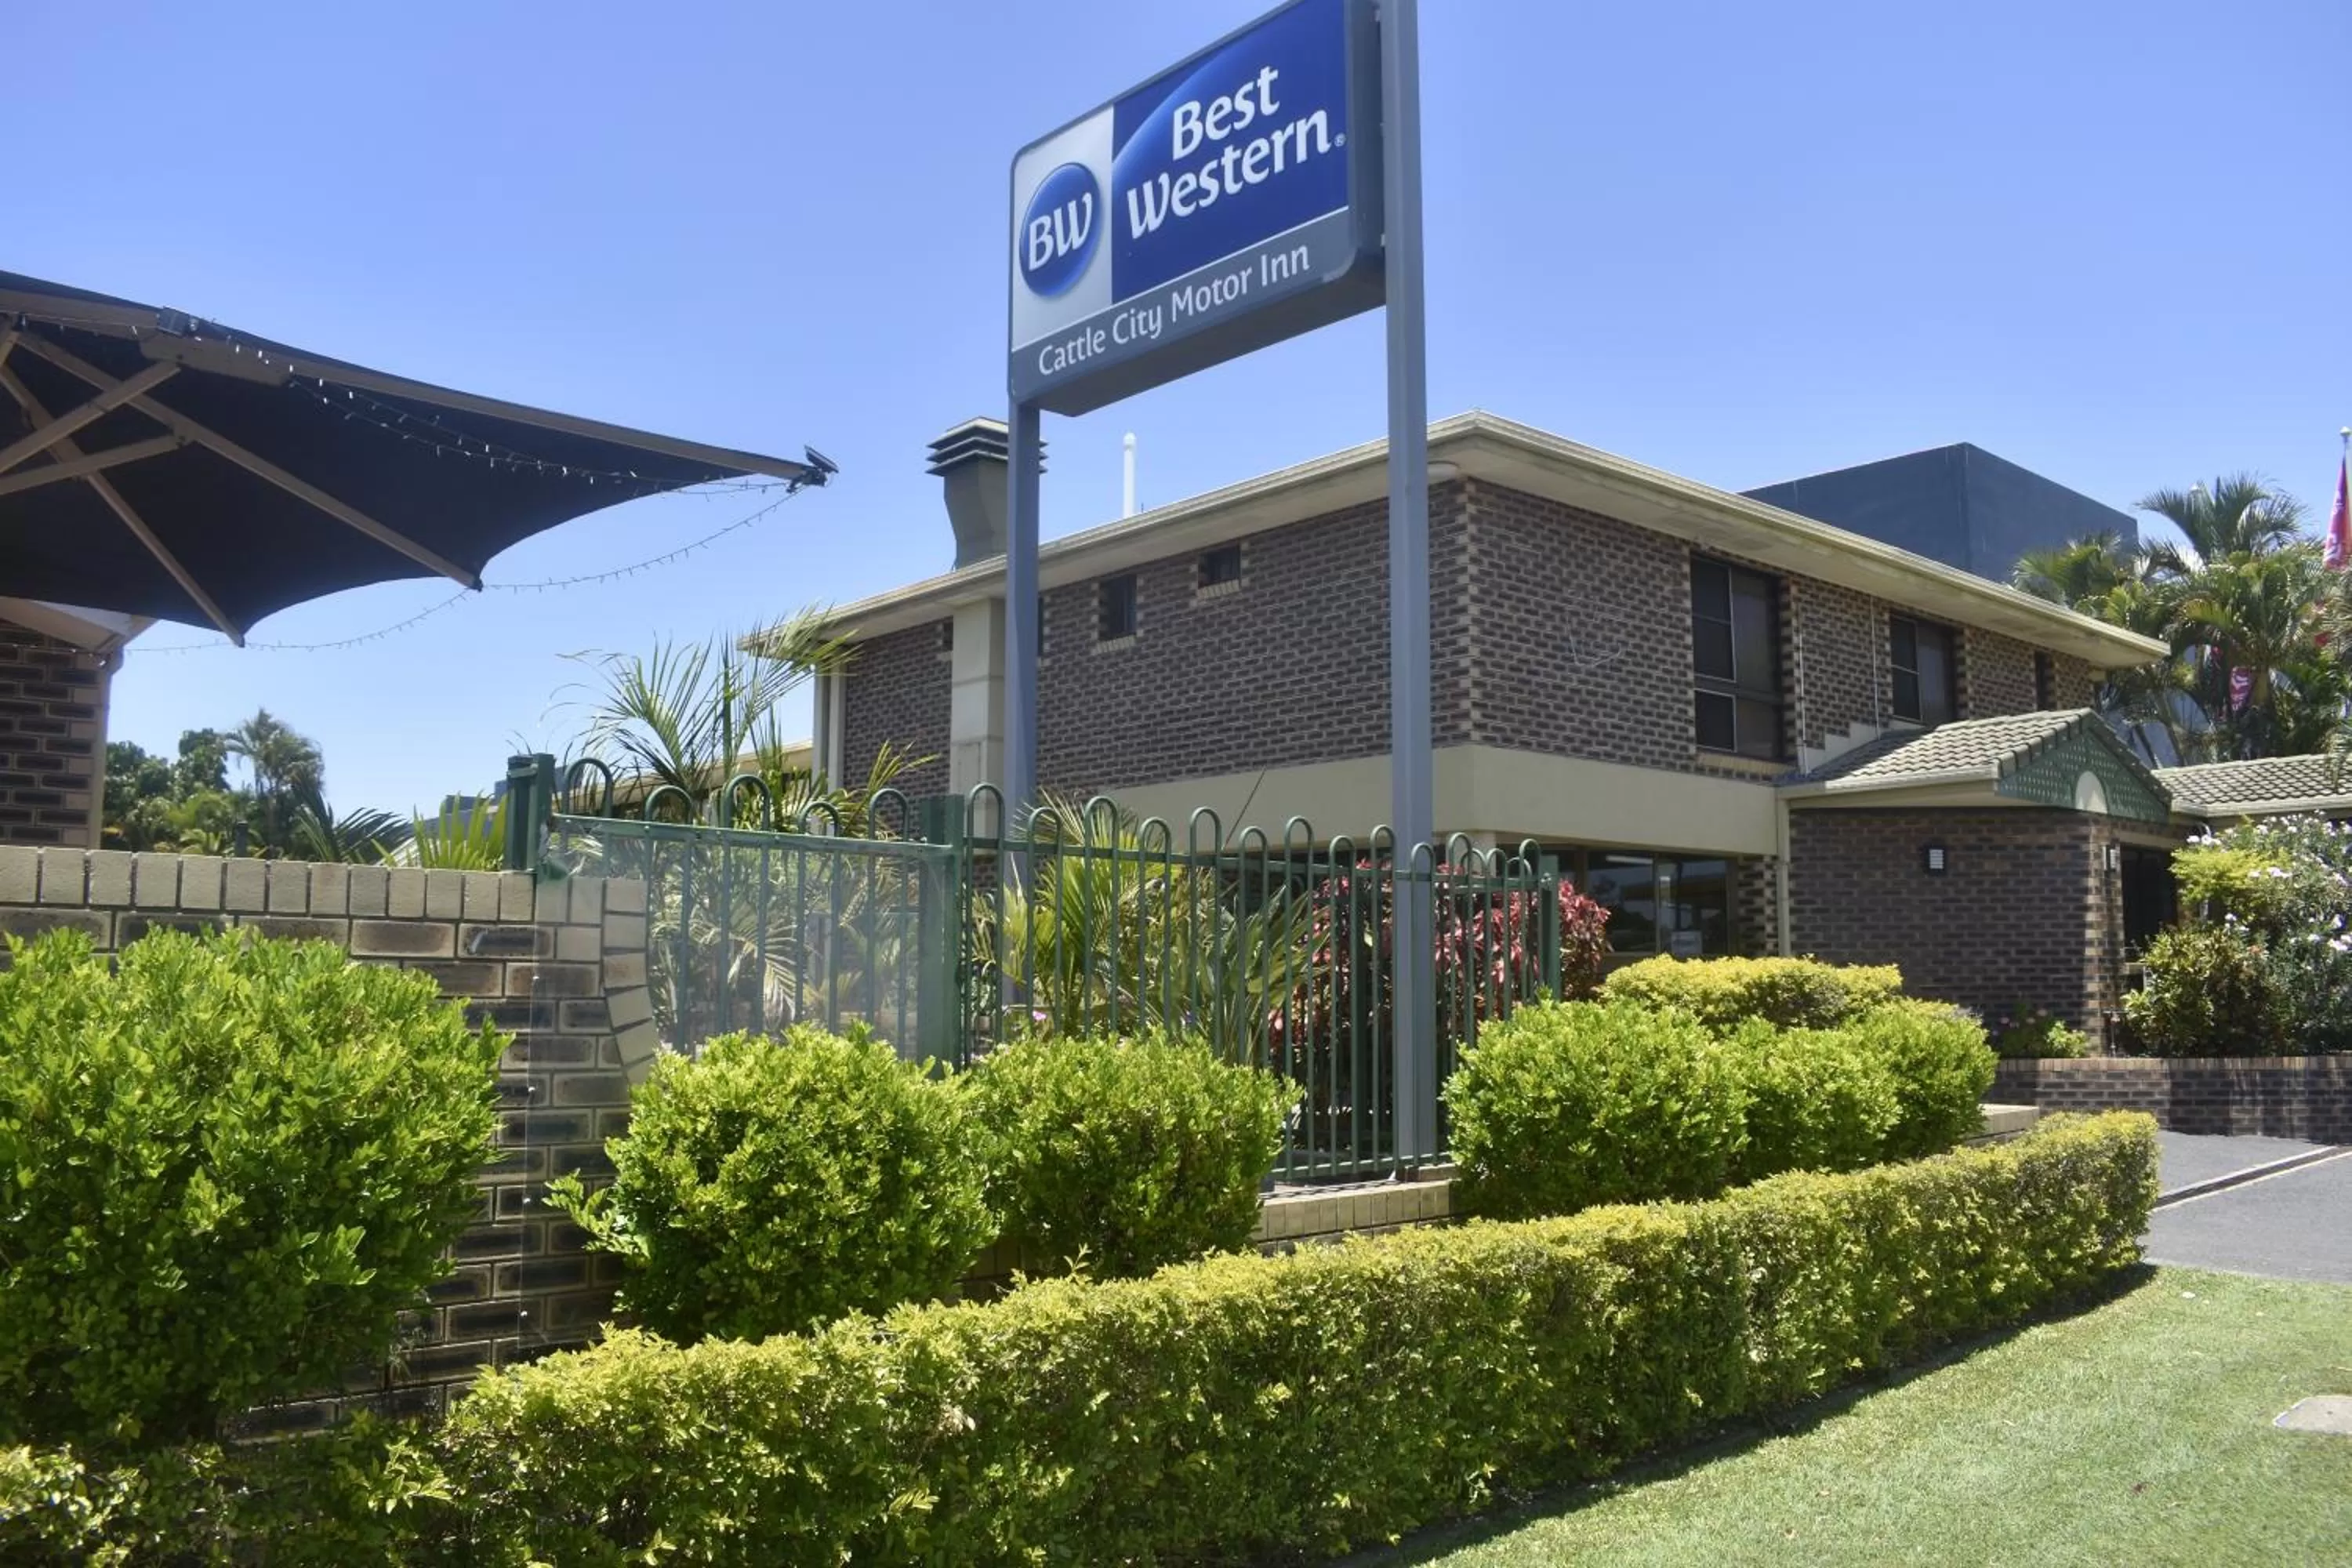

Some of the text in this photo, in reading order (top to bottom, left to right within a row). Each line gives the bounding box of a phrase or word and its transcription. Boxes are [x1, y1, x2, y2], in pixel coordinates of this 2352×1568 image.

[1173, 66, 1279, 160] Best
[1127, 110, 1332, 238] Western
[1028, 192, 1093, 270] BW
[1039, 245, 1309, 376] Cattle City Motor Inn
